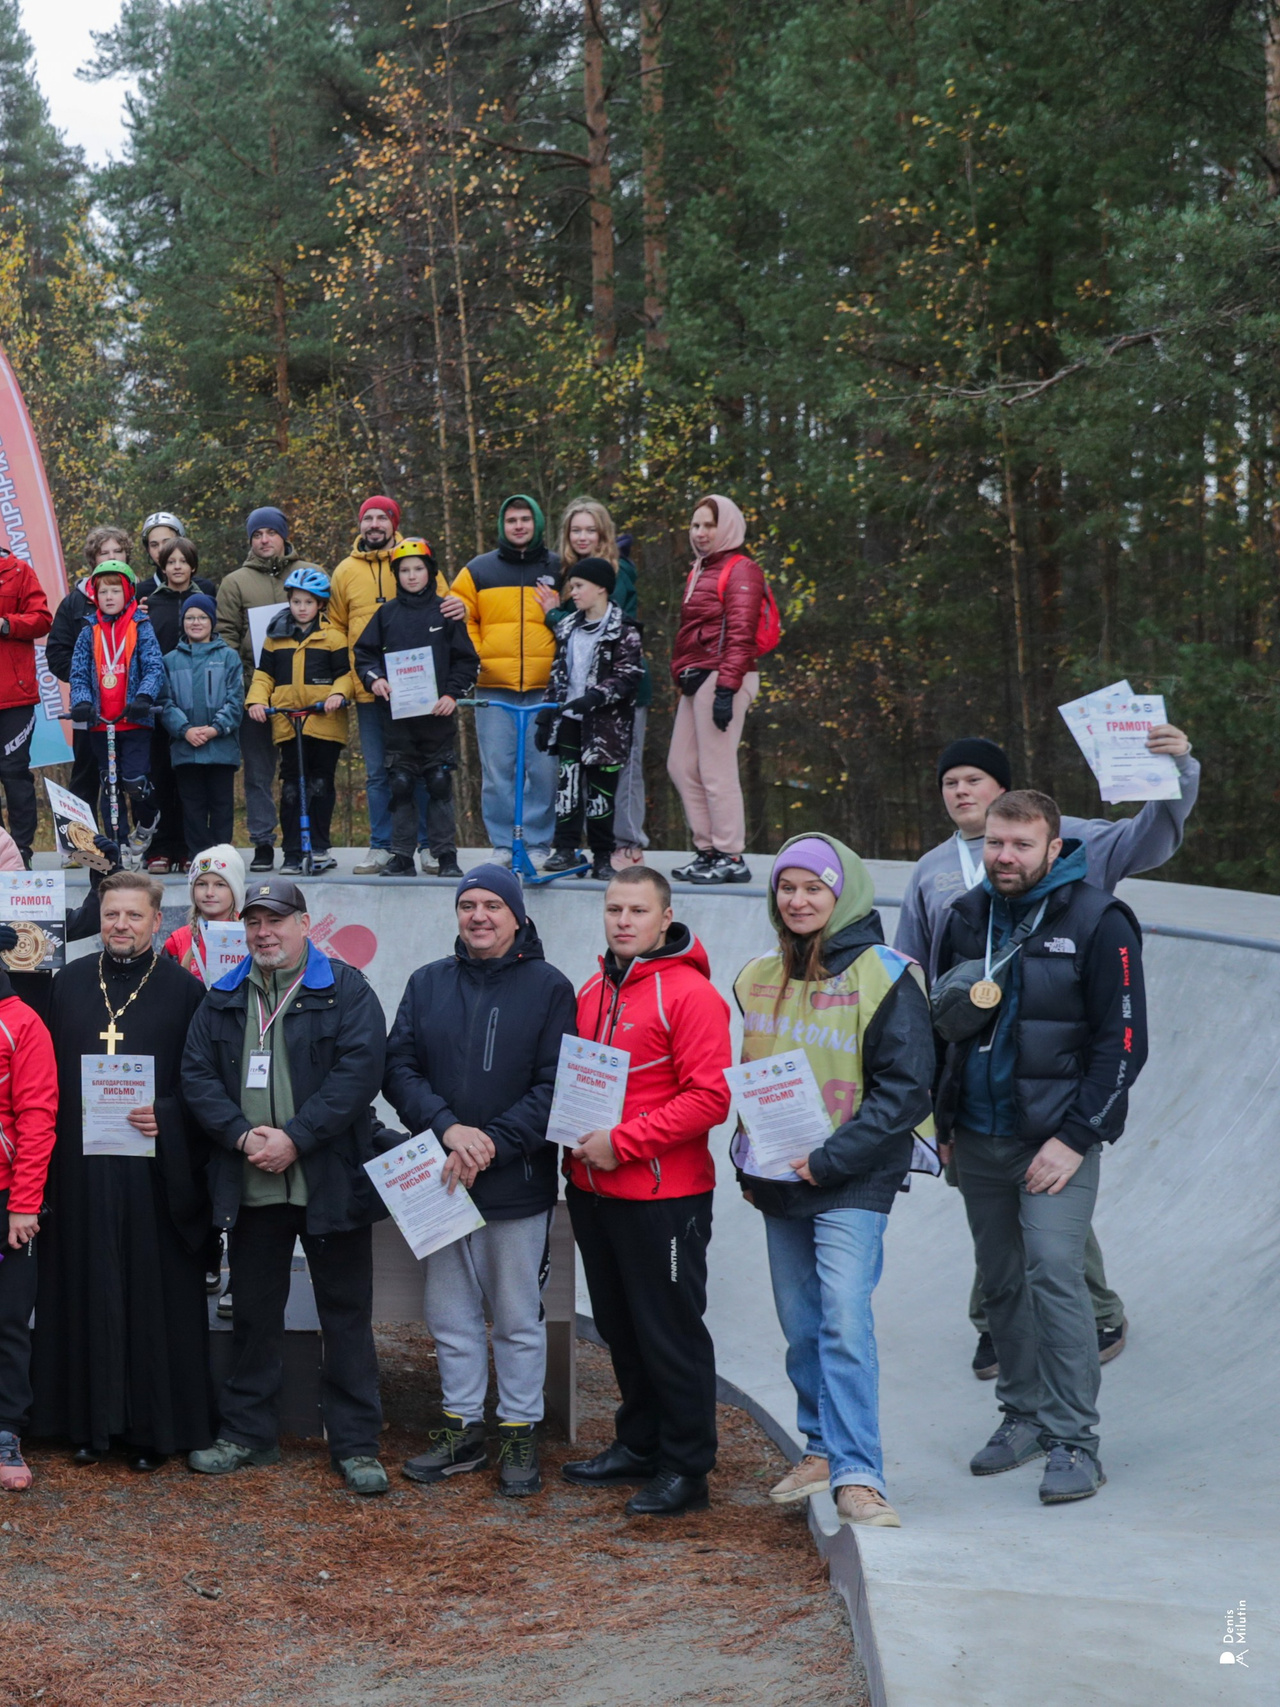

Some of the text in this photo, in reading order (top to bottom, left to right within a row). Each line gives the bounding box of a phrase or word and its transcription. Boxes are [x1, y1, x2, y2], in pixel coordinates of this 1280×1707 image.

[395, 664, 425, 676] ГРАМОТА
[1106, 721, 1154, 732] ГРАМОТА
[10, 895, 52, 906] ГРАМОТА
[219, 954, 245, 964] ГРАМ
[1122, 993, 1132, 1018] NSK
[567, 1062, 619, 1083] БЛАГОДАРСТВЕННОЕ
[91, 1079, 146, 1087] БЛАГОДАРСТВЕННОЕ
[576, 1073, 607, 1089] ПИСЬМО
[743, 1078, 804, 1099] БЛАГОДАРСТВЕННОЕ
[103, 1087, 135, 1096] ПИСЬМО
[758, 1089, 795, 1106] ПИСЬМО
[385, 1156, 438, 1188] БЛАГОДАРСТВЕННОЕ
[399, 1169, 431, 1191] ПИСЬМО
[670, 1236, 678, 1282] FINNTRAIL
